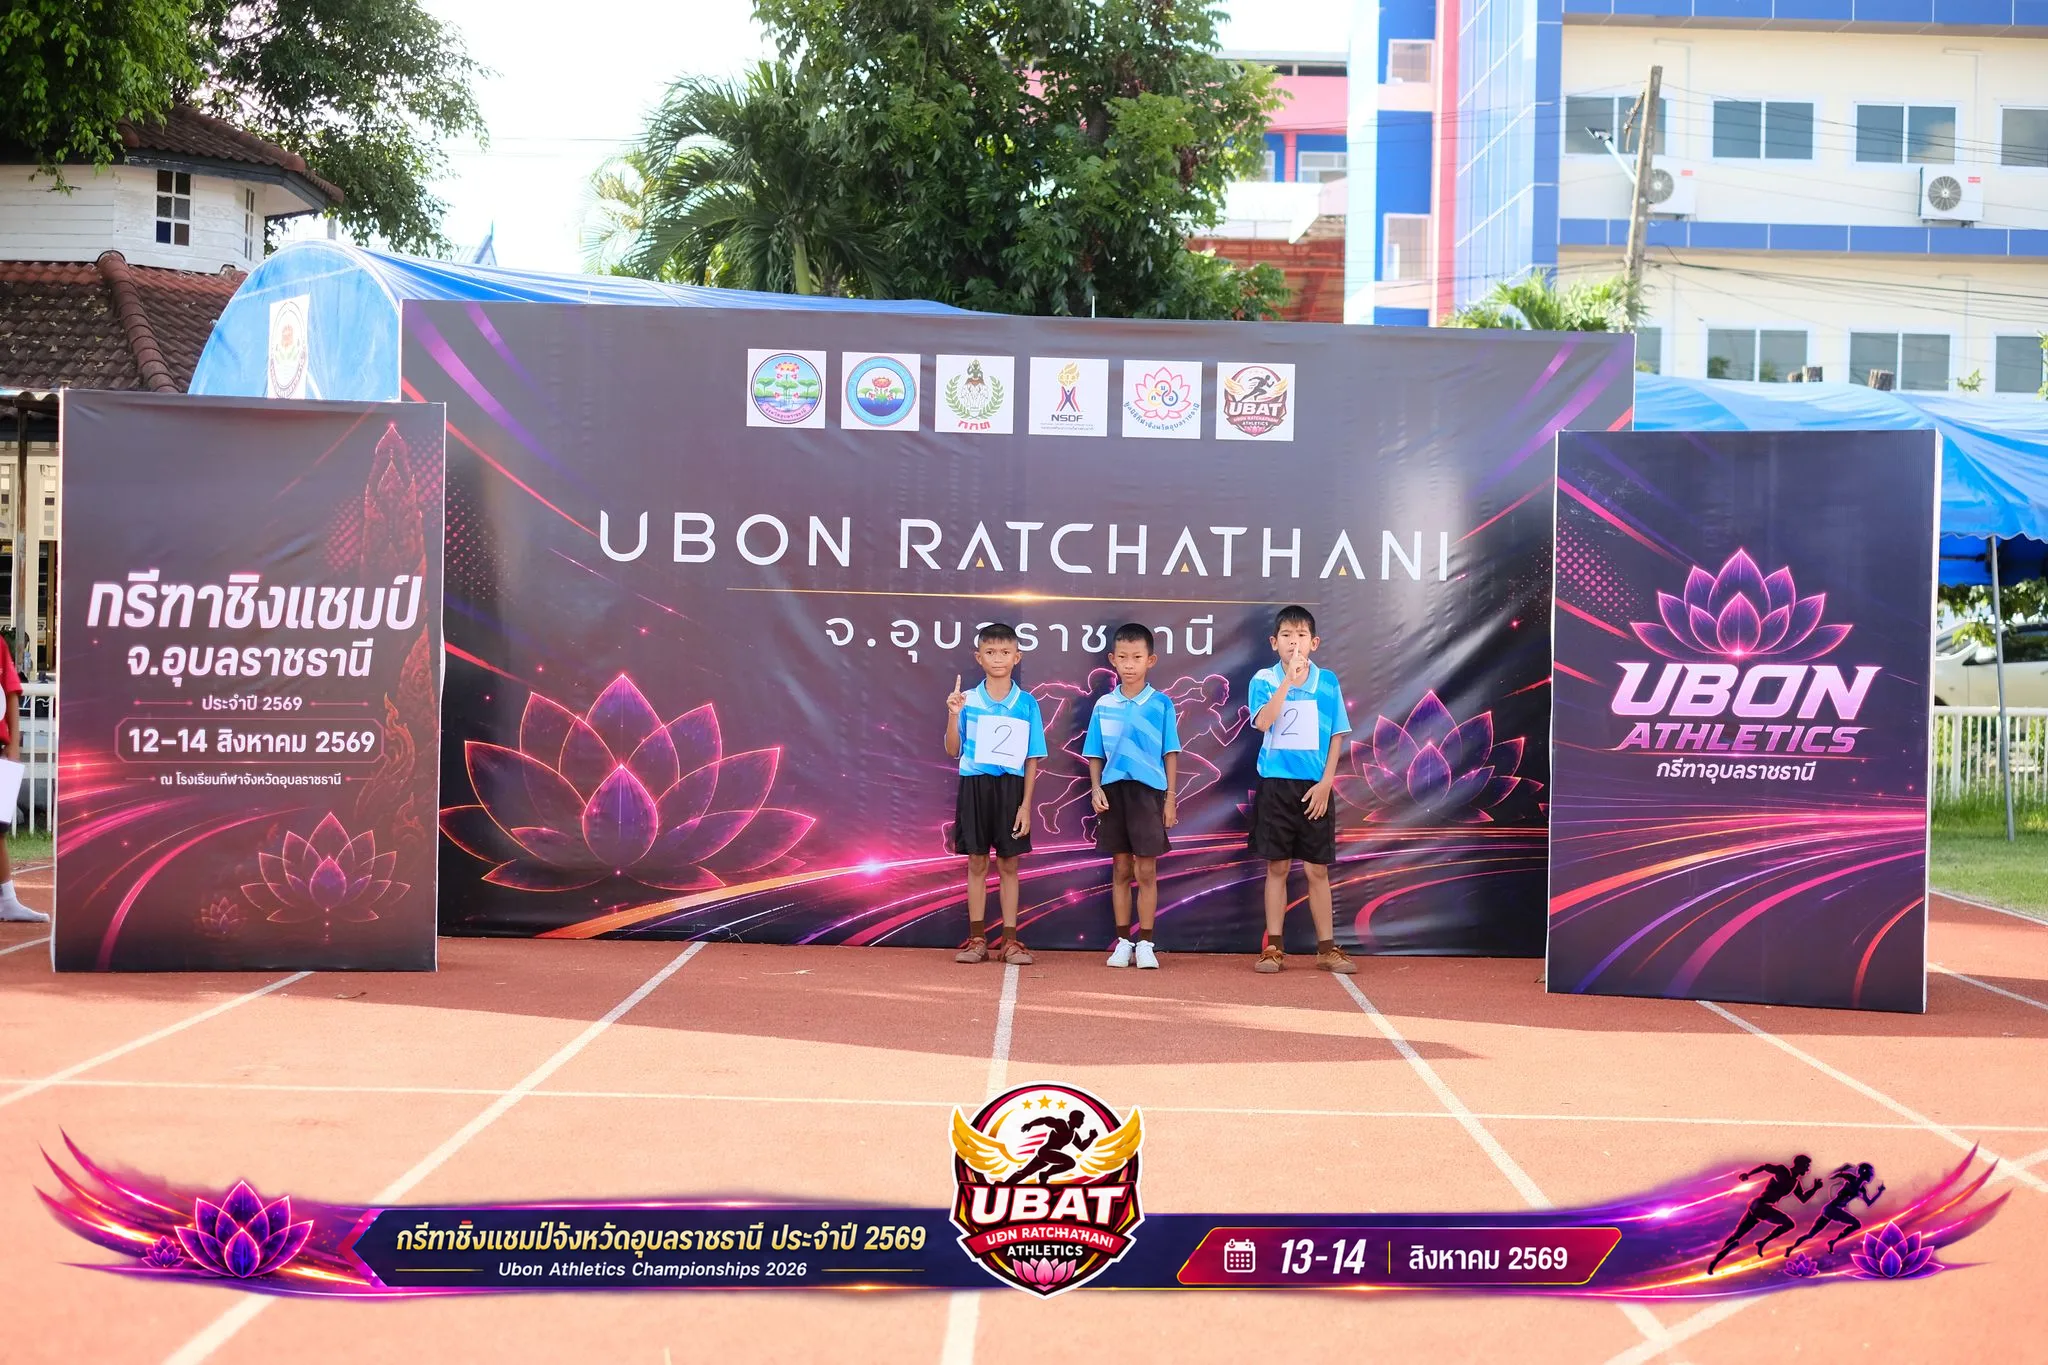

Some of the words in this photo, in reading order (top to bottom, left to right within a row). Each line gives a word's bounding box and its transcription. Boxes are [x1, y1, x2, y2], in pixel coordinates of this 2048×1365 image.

[1051, 414, 1083, 422] NSDF
[1229, 402, 1283, 417] UBAT
[600, 510, 851, 567] UBON
[900, 518, 1449, 581] RATCHATHANI
[86, 569, 423, 630] กรีฑาชิงแชมป์
[825, 614, 1214, 663] จ.อุบราชานี
[127, 638, 374, 687] จ.อุบลราชธานี
[202, 695, 257, 711] ประจำปี
[262, 697, 302, 711] 2569
[1611, 662, 1883, 720] UBON
[1280, 708, 1299, 736] 2
[216, 728, 307, 752] สิงหาคม
[315, 732, 375, 752] 2569
[991, 724, 1016, 757] 2
[1611, 722, 1873, 753] ATHLETICS
[160, 774, 173, 786] ณ
[176, 771, 342, 789] โรงเรียนกีฬาจังหวัดอุบลราชธานี
[1656, 758, 1817, 785] กรีฑาอุบลราชธานี
